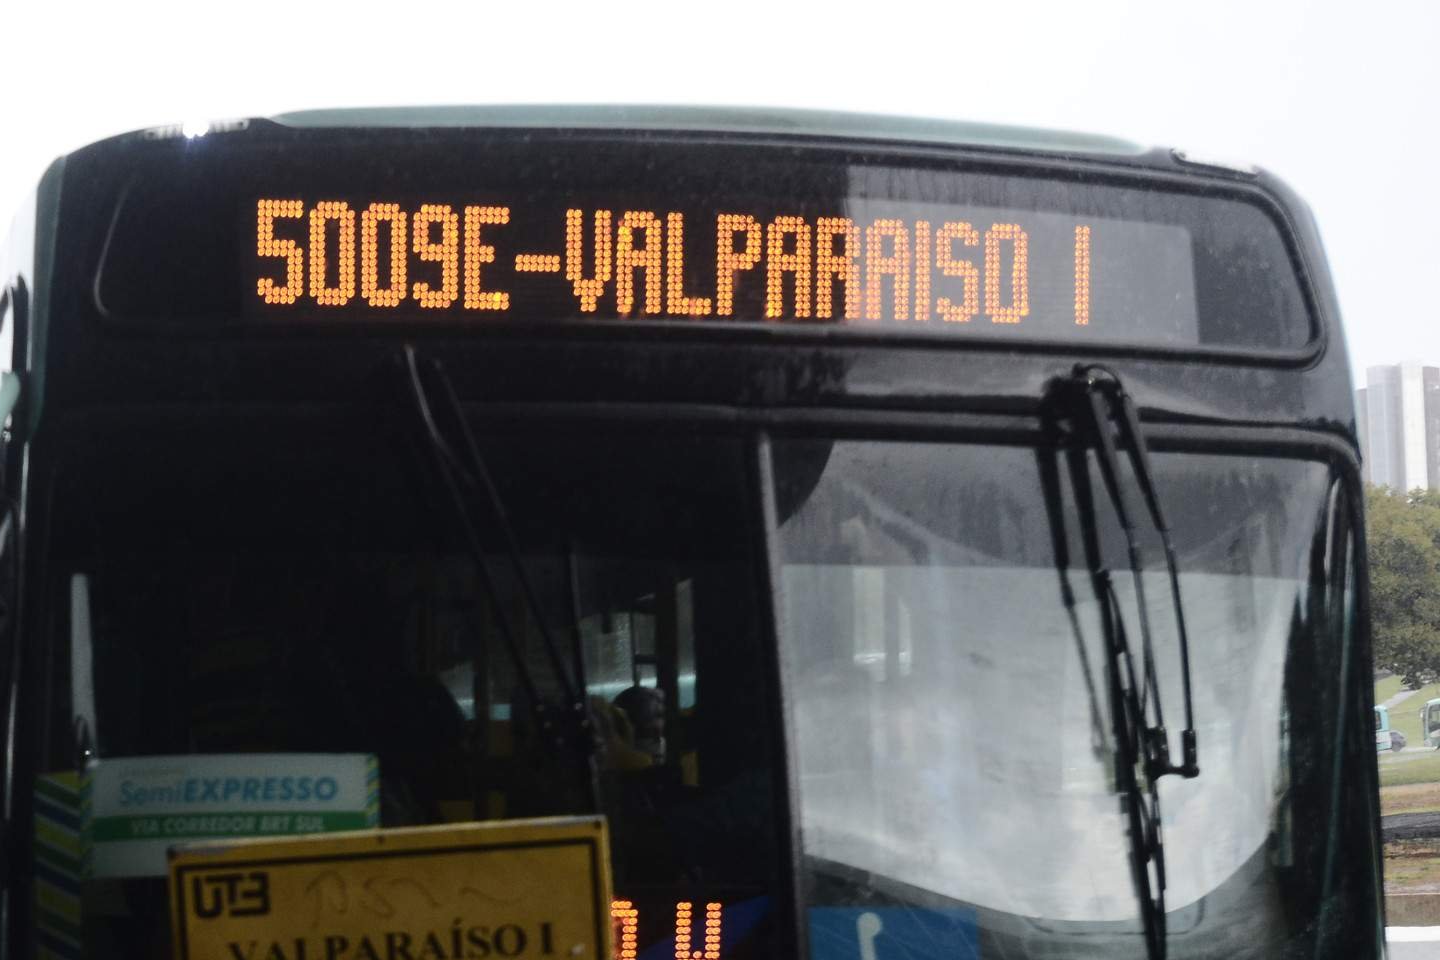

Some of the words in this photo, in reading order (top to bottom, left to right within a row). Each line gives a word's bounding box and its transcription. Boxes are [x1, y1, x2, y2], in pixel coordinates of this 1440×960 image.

[257, 198, 1029, 325] 5009E-VALPARAISO
[129, 818, 160, 836] VIA
[163, 815, 256, 834] CORREDOR
[295, 815, 324, 832] SUL
